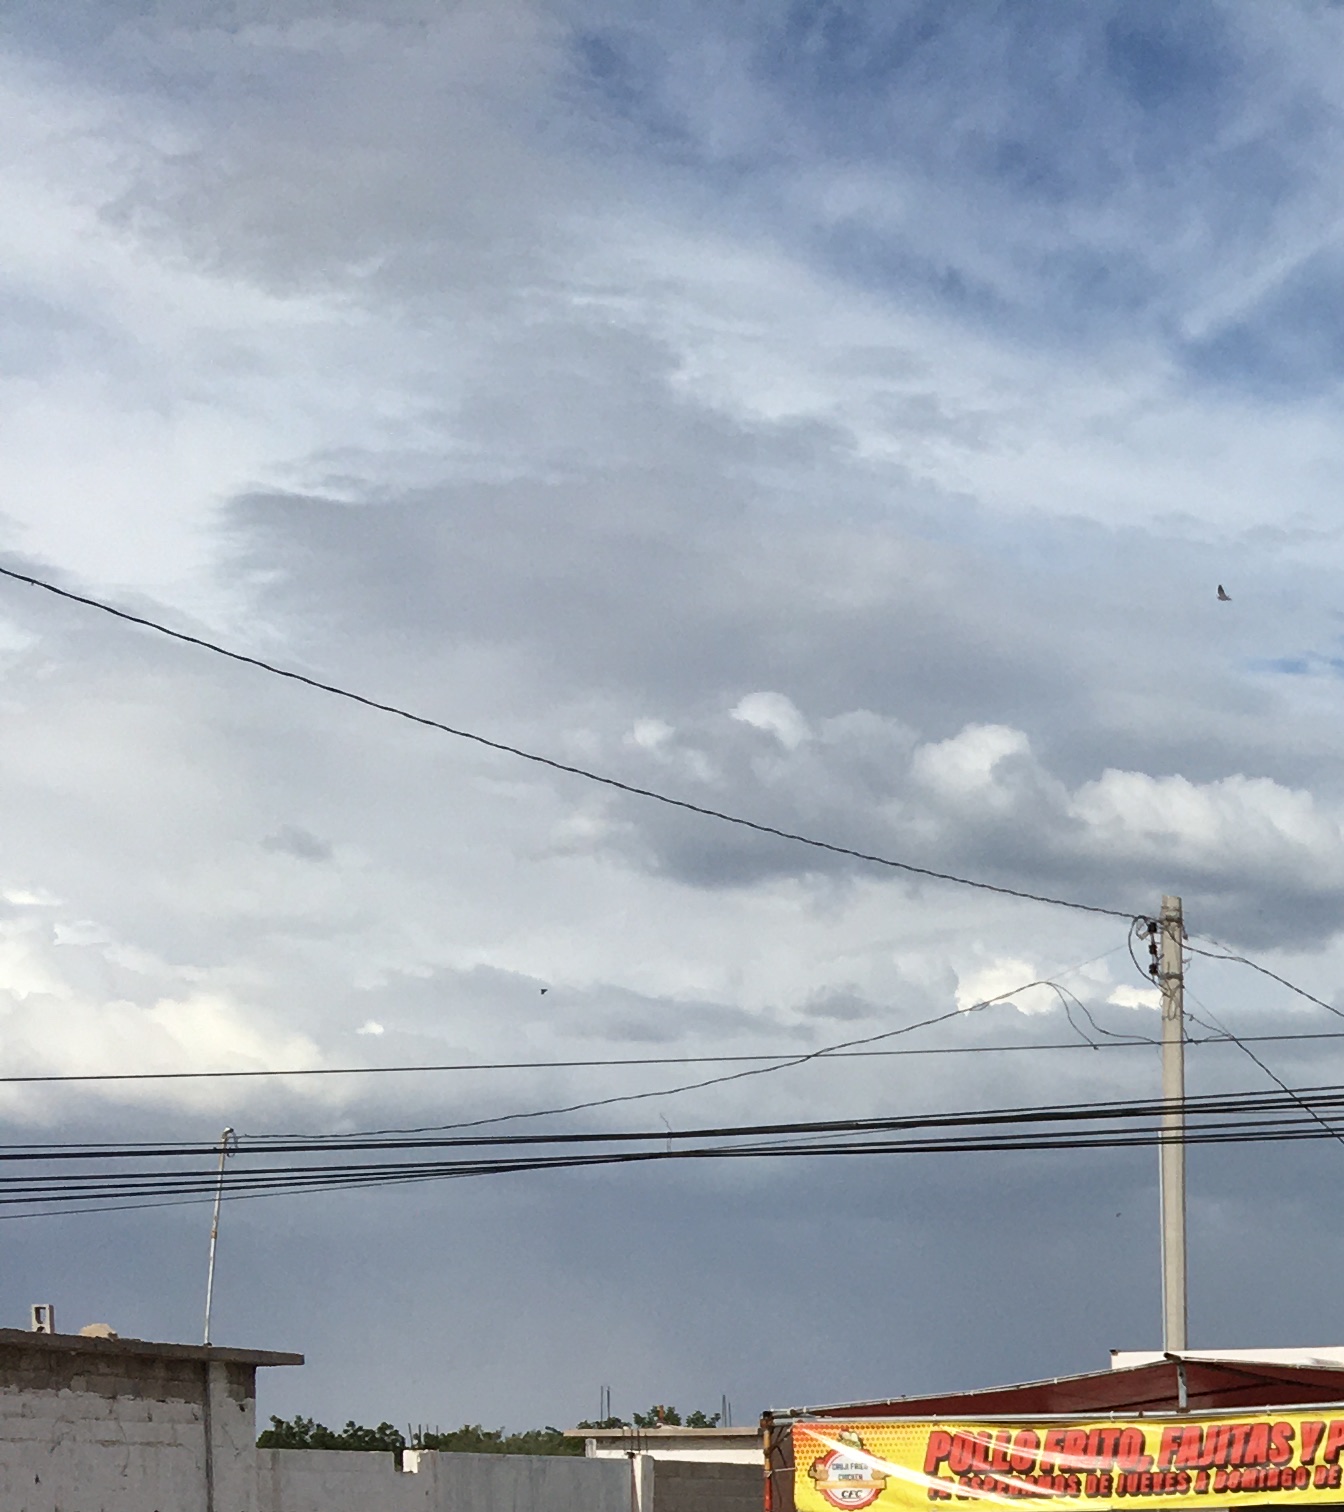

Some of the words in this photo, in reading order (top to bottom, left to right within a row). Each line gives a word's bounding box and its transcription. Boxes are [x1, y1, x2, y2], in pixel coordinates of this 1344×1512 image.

[923, 1429, 1041, 1475] POLLO
[1041, 1427, 1153, 1474] FRITO,
[1156, 1421, 1295, 1471] FAJITAS
[1300, 1421, 1326, 1465] Y
[1085, 1473, 1113, 1498] DE
[1115, 1471, 1191, 1497] JUEVES
[1194, 1469, 1209, 1495] A
[1213, 1466, 1310, 1493] DOMINGO
[1313, 1464, 1341, 1489] DE
